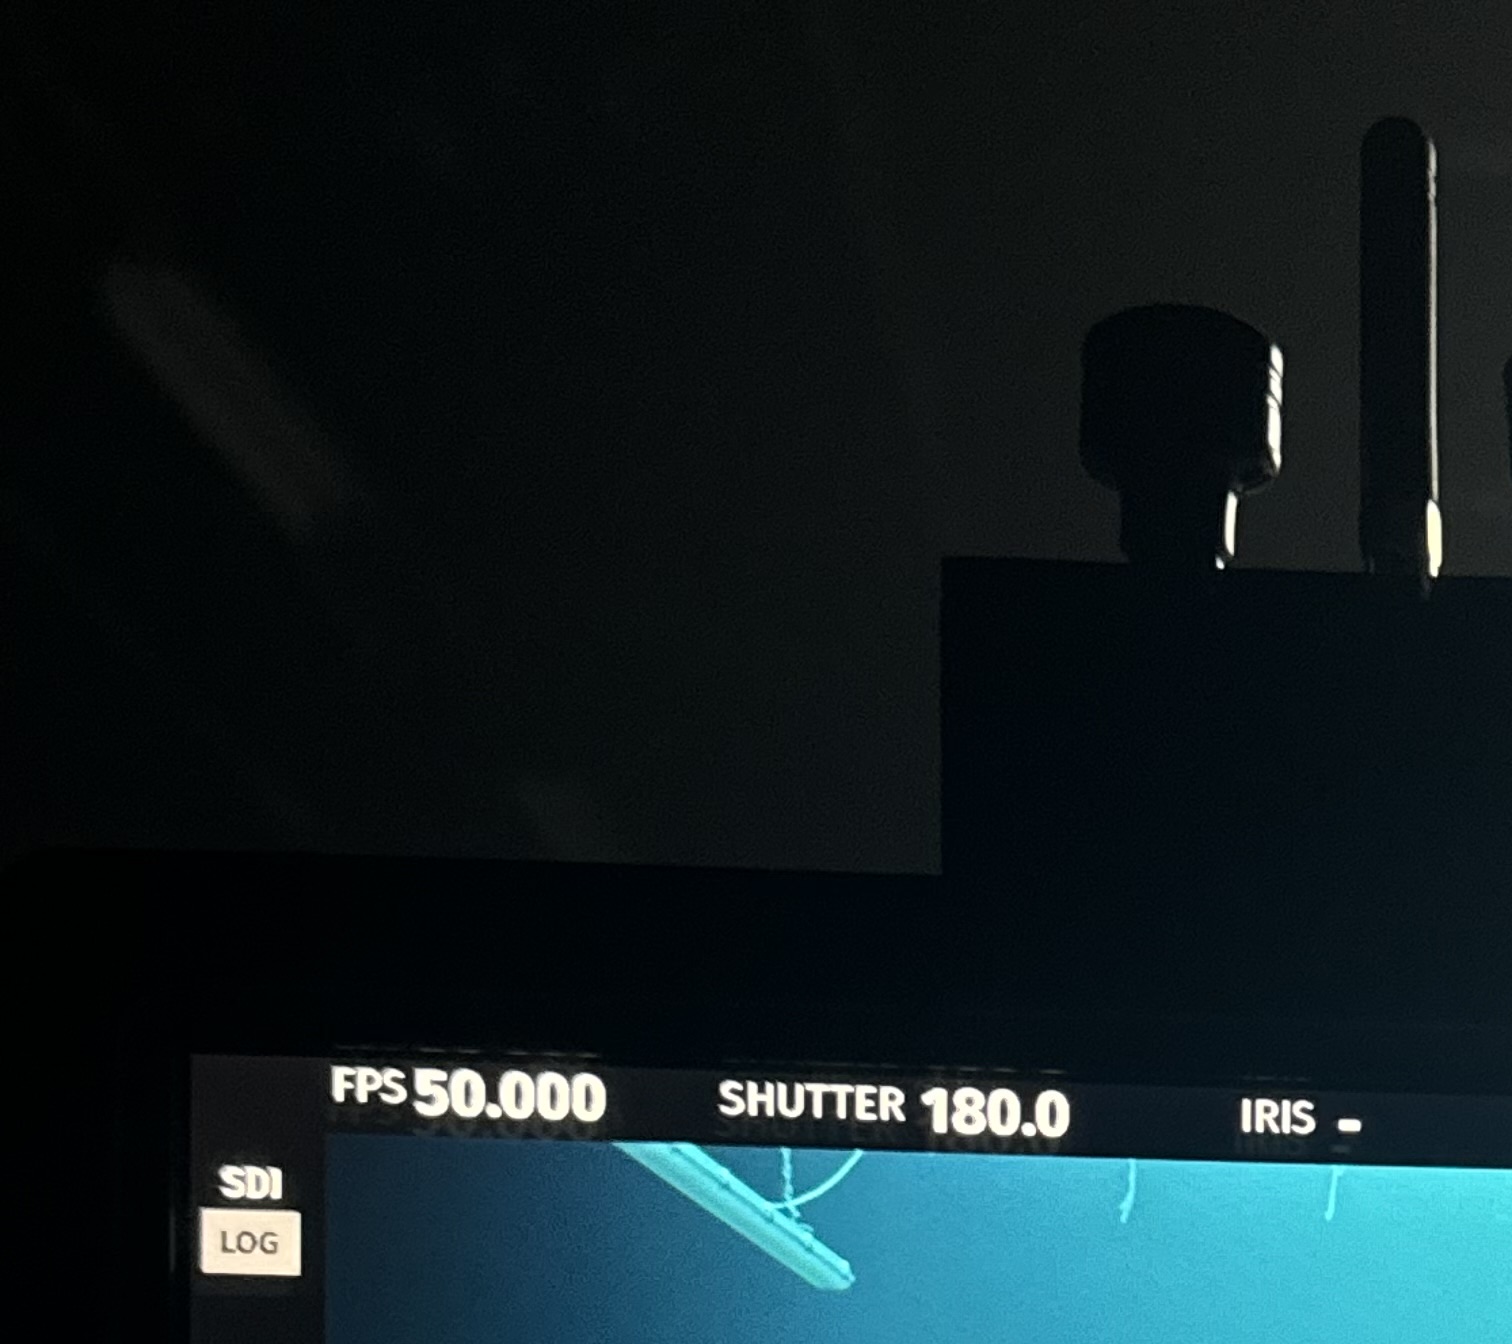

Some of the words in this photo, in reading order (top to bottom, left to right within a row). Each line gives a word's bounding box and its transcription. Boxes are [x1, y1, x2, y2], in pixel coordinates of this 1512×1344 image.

[331, 1065, 408, 1105] FPS
[412, 1067, 607, 1123] 50.000
[718, 1079, 907, 1122] SHUTTER
[920, 1086, 1071, 1139] 180.0
[1241, 1097, 1317, 1135] IRIS
[218, 1164, 283, 1201] SDI
[220, 1230, 279, 1254] LOG
